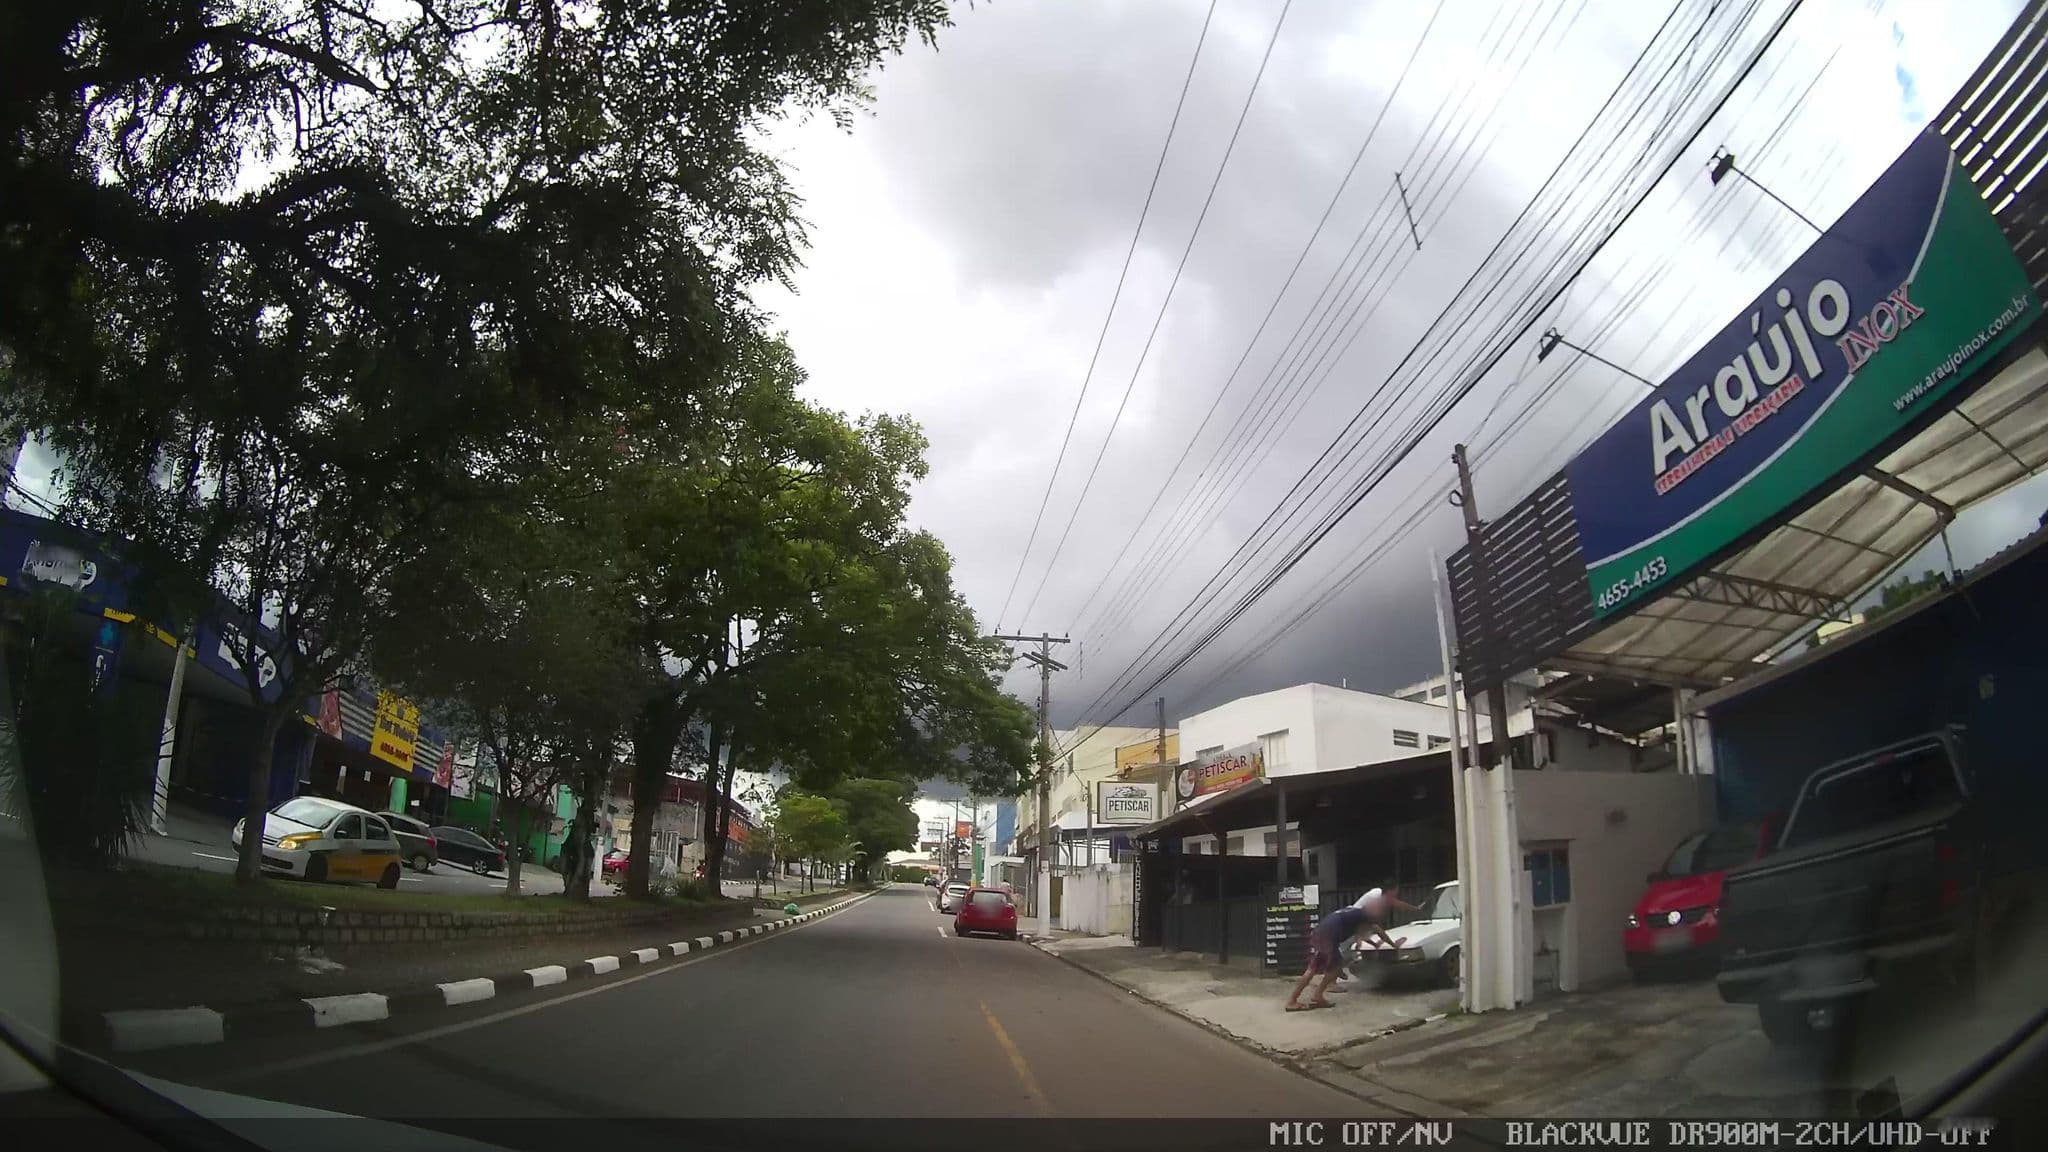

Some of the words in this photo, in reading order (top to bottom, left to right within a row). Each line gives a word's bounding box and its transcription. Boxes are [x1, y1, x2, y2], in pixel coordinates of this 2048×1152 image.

[1835, 281, 1925, 375] INOX
[1892, 294, 2029, 411] www.araujoinox.com.br
[1650, 278, 1850, 476] Araújo
[1598, 556, 1667, 609] 4655-4453
[1199, 755, 1247, 779] PETISCAR
[1108, 799, 1149, 812] PETISCAR
